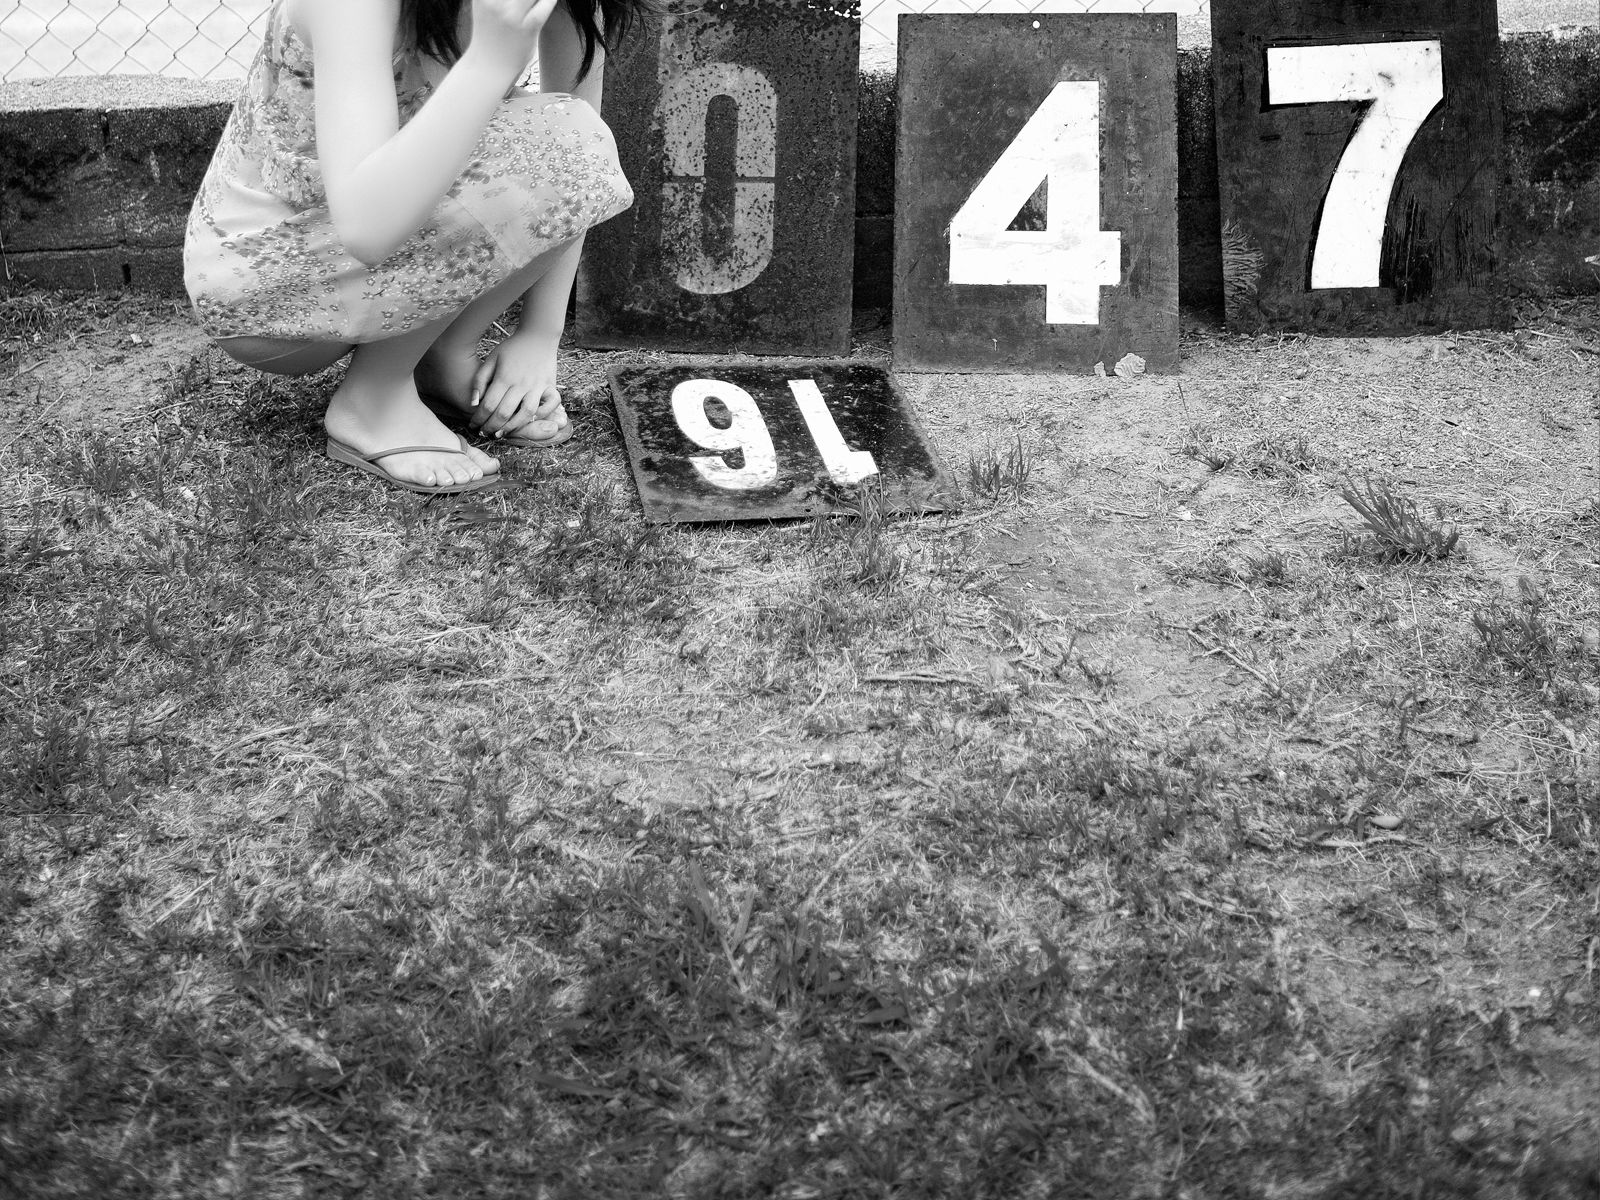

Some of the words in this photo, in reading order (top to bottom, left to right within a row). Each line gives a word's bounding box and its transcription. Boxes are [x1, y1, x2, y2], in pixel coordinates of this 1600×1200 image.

[662, 62, 778, 295] 0
[948, 80, 1121, 325] 4
[1266, 39, 1444, 290] 7
